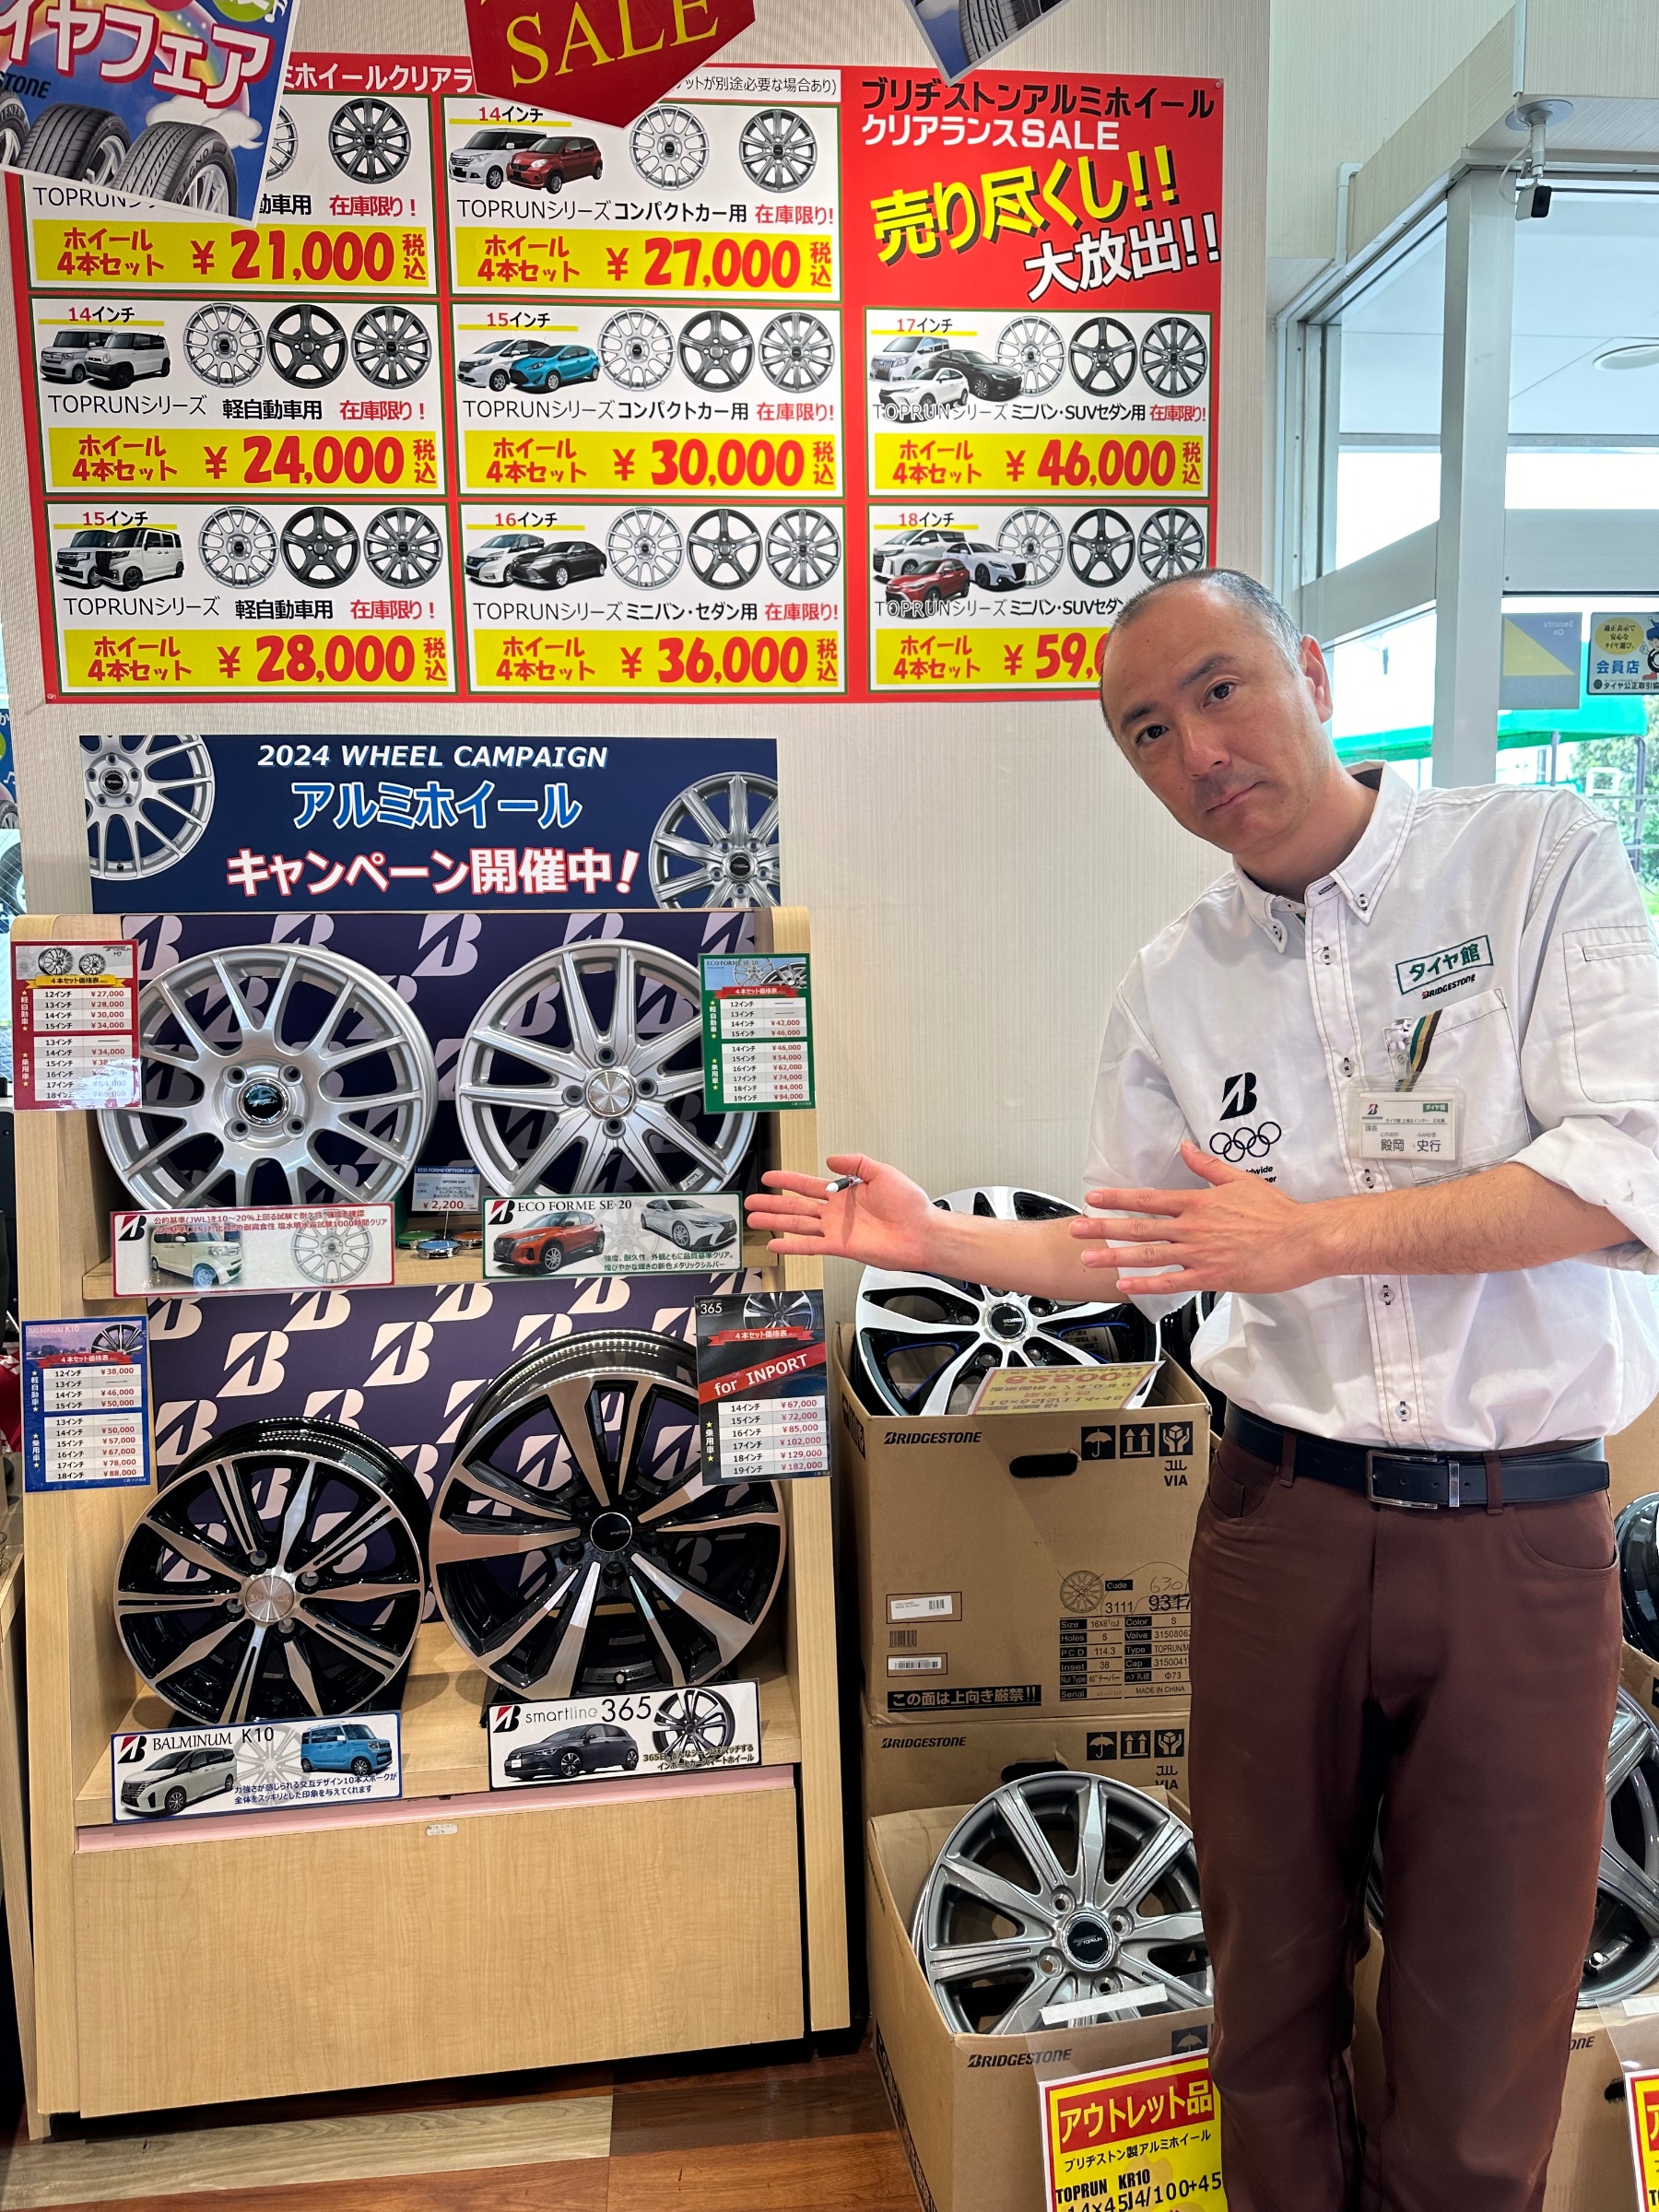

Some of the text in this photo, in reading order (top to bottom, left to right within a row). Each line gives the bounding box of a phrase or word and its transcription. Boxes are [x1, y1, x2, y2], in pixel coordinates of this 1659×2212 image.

[506, 0, 719, 88] SALE
[478, 106, 544, 123] 14インチ
[862, 114, 1120, 150] クリアランスSALE
[64, 228, 153, 252] ホイール
[485, 234, 570, 258] ホイール
[57, 252, 164, 276] 4本セット
[230, 229, 395, 282] 21,000
[644, 238, 801, 288] 27,000
[478, 259, 580, 283] 4本セット
[68, 306, 135, 324] 14インチ
[487, 312, 550, 328] 15インチ
[897, 317, 953, 335] 17インチ
[222, 400, 323, 420] 軽自動車用
[78, 434, 166, 458] ホイール
[493, 437, 576, 460] ホイール
[900, 440, 973, 462] ホイール
[72, 459, 177, 483] 4本セット
[243, 436, 405, 485] 24,000
[651, 438, 805, 487] 30,000
[1037, 439, 1176, 488] 46,000
[486, 461, 587, 485] 4本セット
[892, 463, 982, 485] 4本セット
[83, 511, 148, 528] 15インチ
[494, 512, 558, 528] 16インチ
[899, 512, 954, 527] 18インチ
[235, 599, 334, 620] 軽自動車用
[93, 636, 181, 658] ホイール
[502, 636, 584, 658] ホイール
[900, 635, 972, 657] ホイール
[255, 634, 415, 684] 28,000
[657, 636, 808, 684] 36,000
[893, 658, 981, 680] 4本セット
[1596, 660, 1640, 675] 会員店
[88, 659, 192, 683] 4本セット
[496, 659, 595, 682] 4本セット
[258, 745, 608, 769] 2024 WHEEL CAMPAIGN
[291, 780, 582, 830] アルミホイール
[227, 847, 640, 897] キャンペーン開催中!
[1409, 943, 1481, 982] タイヤ館
[518, 1202, 545, 1211] ECO
[549, 1201, 596, 1211] FORME
[700, 1302, 723, 1314] 365
[714, 1354, 807, 1396] for INPORT
[883, 1431, 982, 1445] BRIDGESTONE
[1163, 1475, 1188, 1487] VIA
[1107, 1582, 1128, 1590] Code
[1105, 1601, 1133, 1613] 3111
[1061, 1619, 1079, 1629] Size
[1126, 1617, 1148, 1627] Color
[1061, 1633, 1108, 1642] Holes 5
[1125, 1630, 1148, 1640] Valve
[1094, 1646, 1116, 1656] 114.3
[1125, 1645, 1146, 1655] Type
[1061, 1660, 1110, 1672] Inset 38
[1126, 1659, 1143, 1669] Cap
[892, 1686, 1037, 1707] この面は上向き厳禁!!
[1135, 1686, 1155, 1695] MADE
[1164, 1685, 1185, 1693] CHINA
[525, 1696, 652, 1724] smartline 365
[153, 1726, 275, 1751] BALMINUM K10
[881, 1736, 968, 1749] BRIDGESTONE
[967, 2048, 1073, 2068] BRIDGESTONE
[1059, 2079, 1213, 2144] アウトレット品
[1055, 2169, 1151, 2204] TOPRUN KR10
